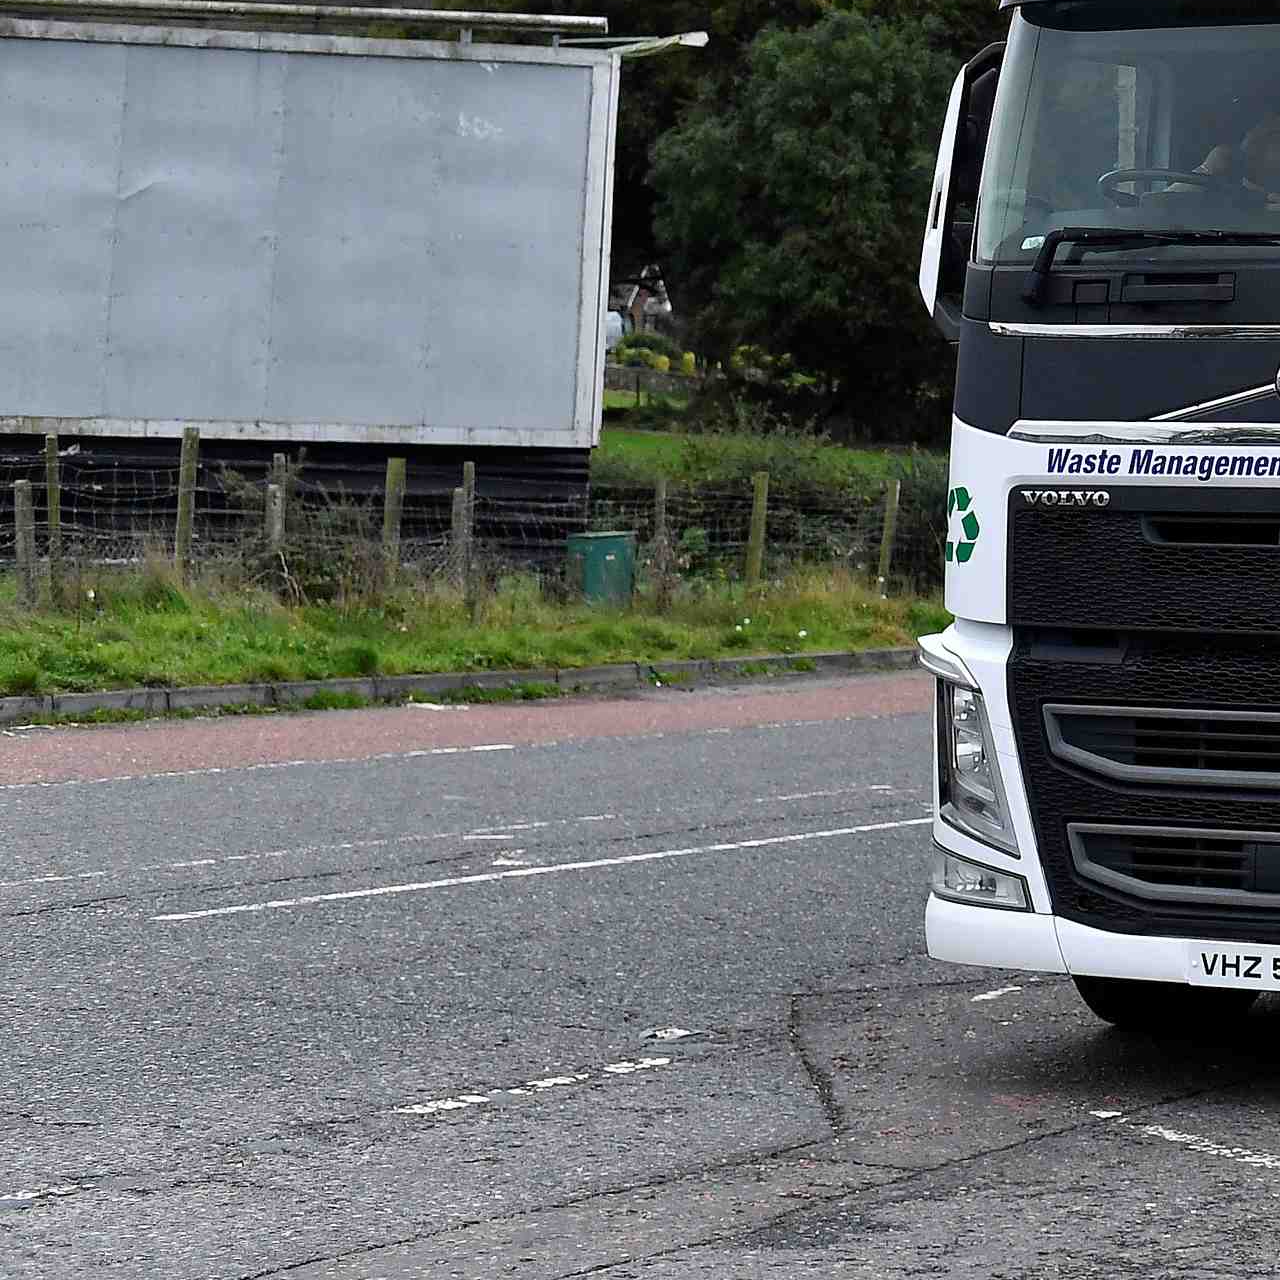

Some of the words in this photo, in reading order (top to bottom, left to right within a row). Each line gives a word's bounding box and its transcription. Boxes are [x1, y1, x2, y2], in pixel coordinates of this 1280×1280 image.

[1047, 448, 1121, 474] Waste
[1020, 489, 1111, 507] VOLVO
[1200, 952, 1263, 979] VHZ
